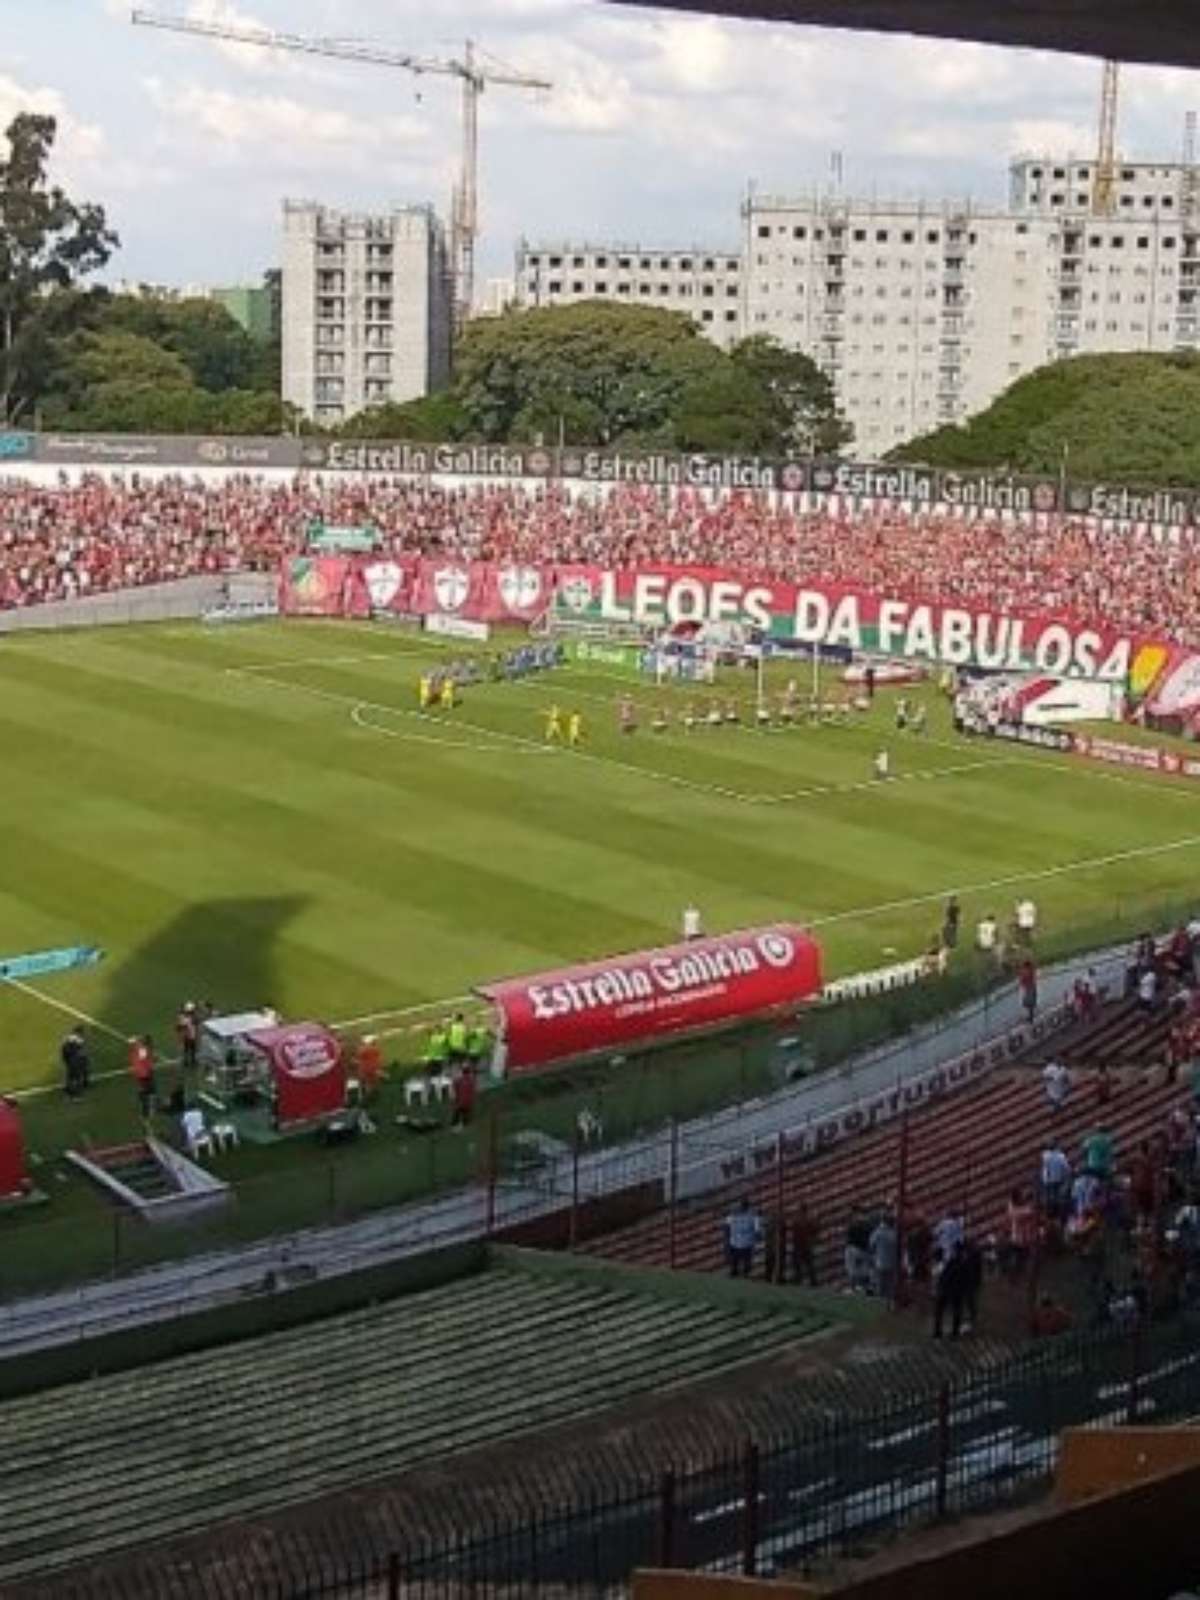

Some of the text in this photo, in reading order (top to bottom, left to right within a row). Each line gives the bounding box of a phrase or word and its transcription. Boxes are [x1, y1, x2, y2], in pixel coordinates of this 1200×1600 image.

[326, 442, 524, 475] Estrella Galicia
[583, 453, 775, 488] Estrella Galicia
[834, 466, 1031, 510] Estrella Galicia
[1089, 487, 1185, 521] Estrella
[793, 590, 862, 650] DA
[878, 599, 1132, 678] FABULOSA
[526, 966, 652, 1020] Estrella
[650, 944, 759, 991] Galicia
